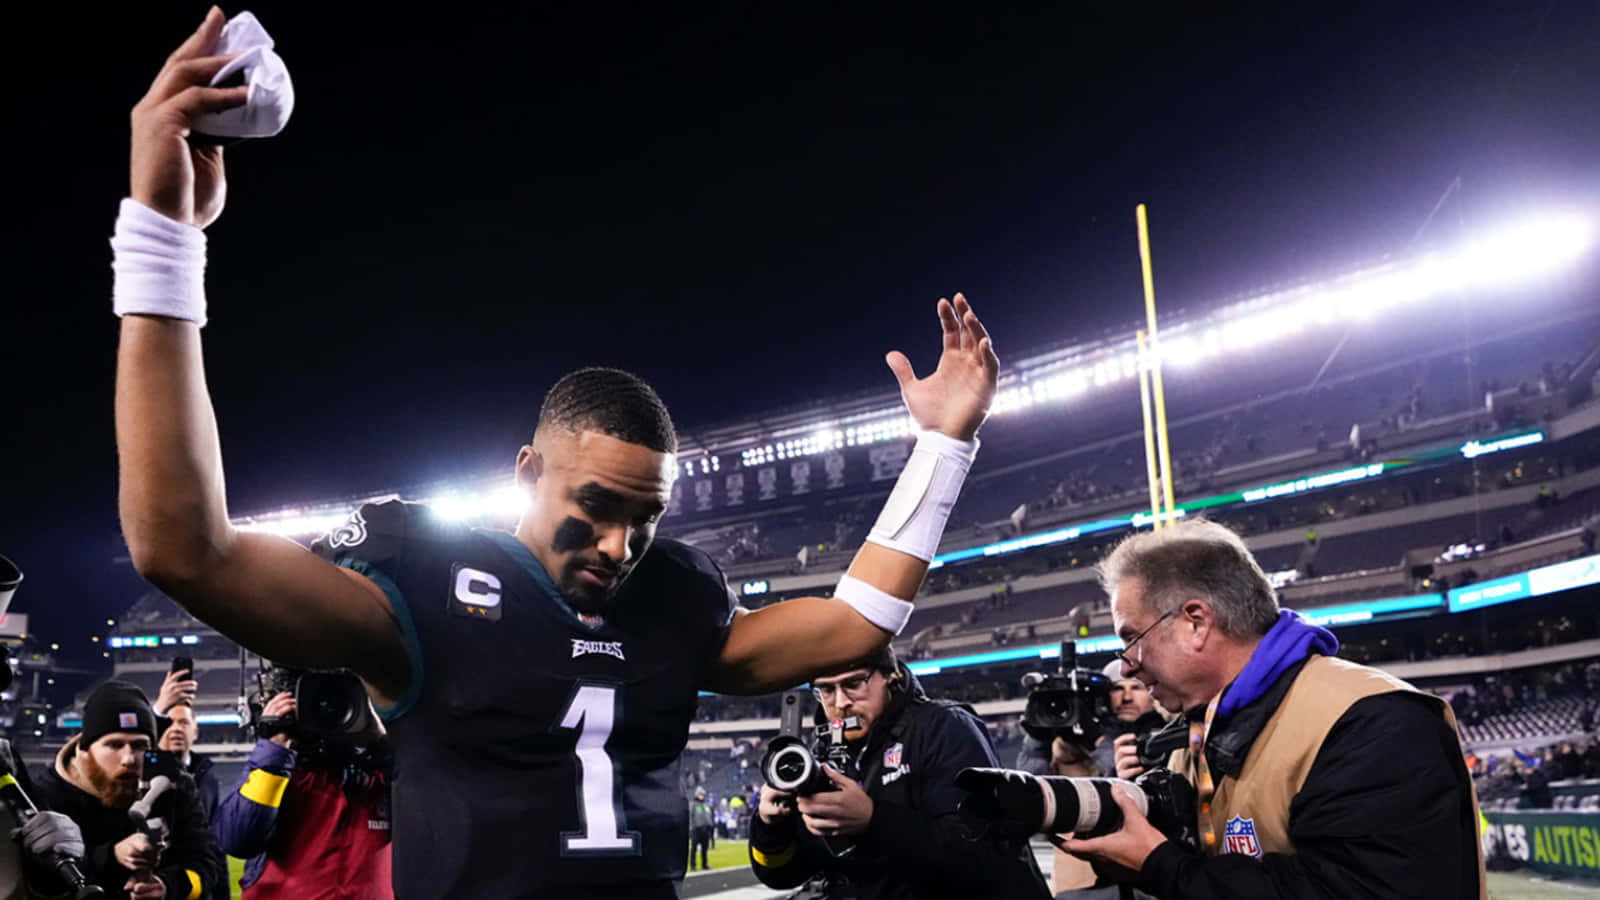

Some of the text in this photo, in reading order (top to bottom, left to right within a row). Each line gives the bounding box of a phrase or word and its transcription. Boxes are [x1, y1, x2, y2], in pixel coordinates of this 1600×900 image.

[455, 567, 502, 607] C
[570, 638, 626, 661] EAGLES
[559, 685, 634, 850] 1
[1226, 834, 1257, 856] NFL
